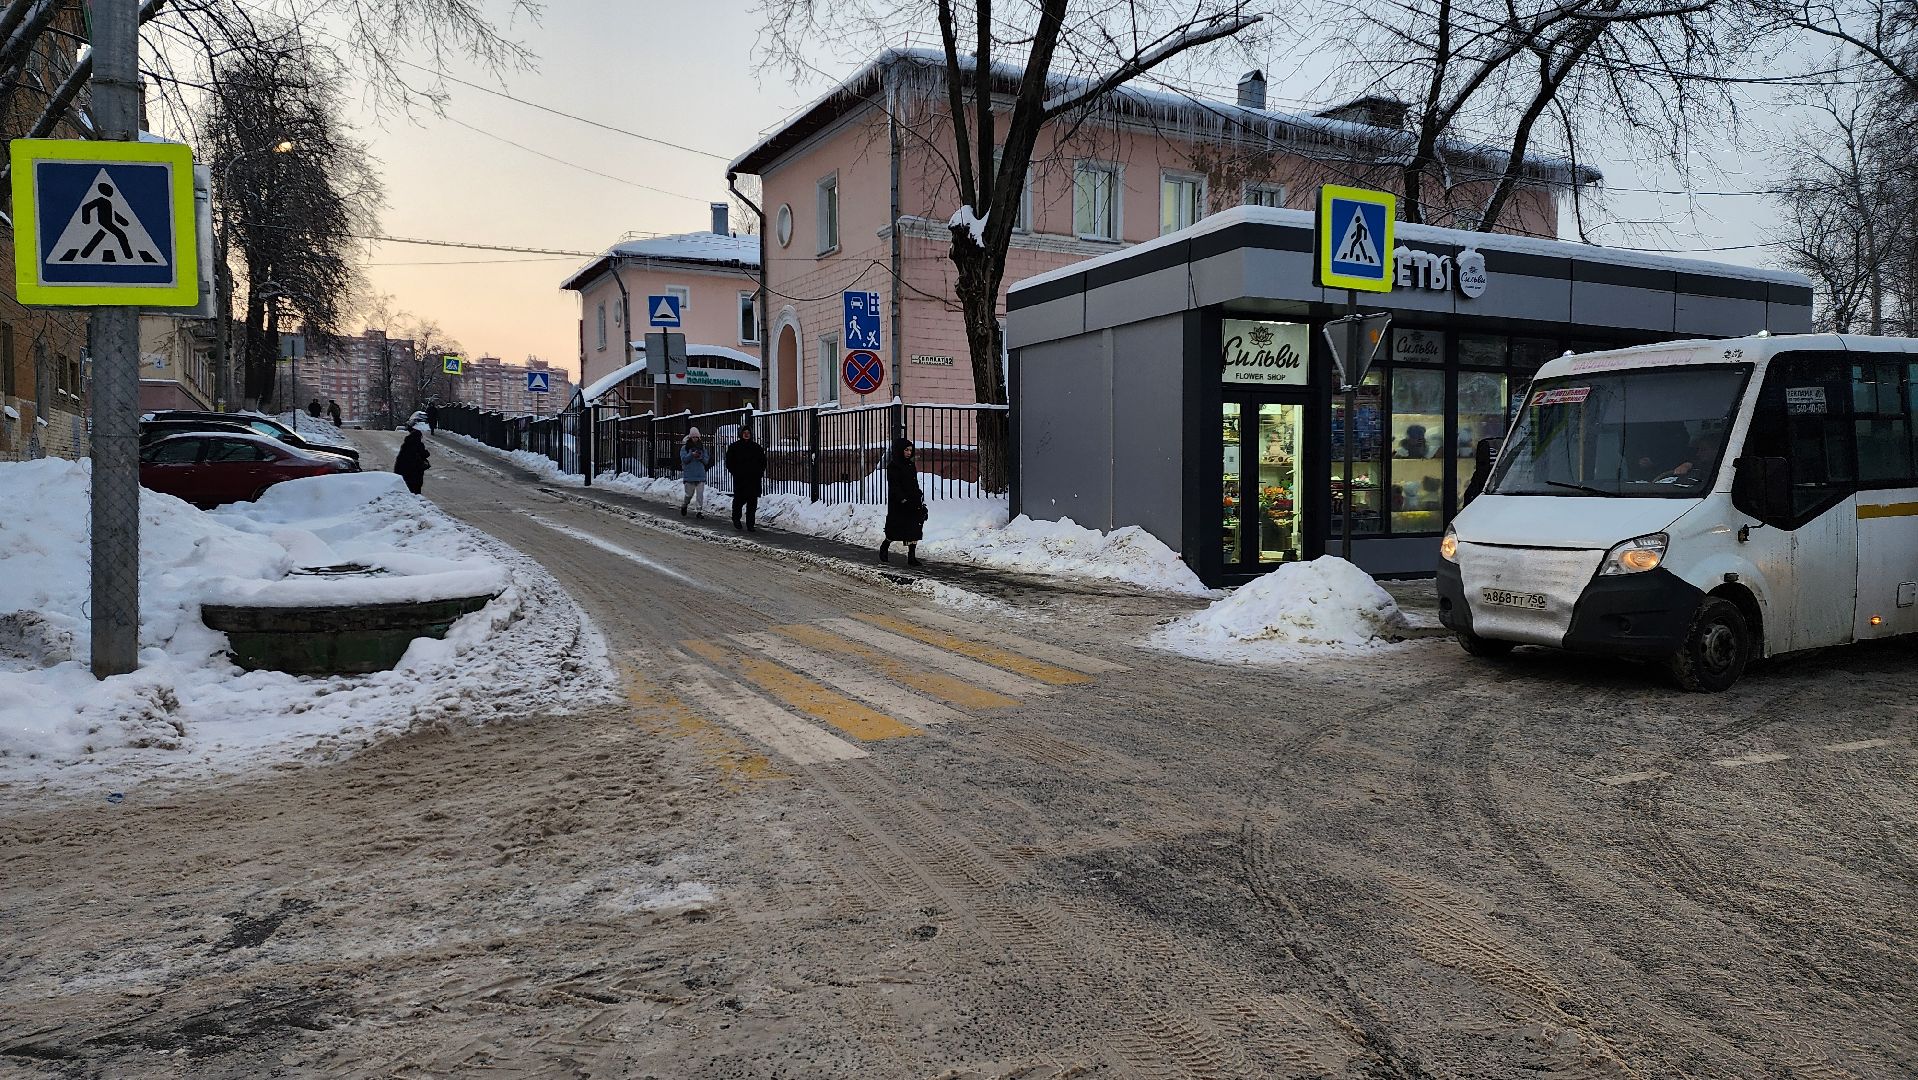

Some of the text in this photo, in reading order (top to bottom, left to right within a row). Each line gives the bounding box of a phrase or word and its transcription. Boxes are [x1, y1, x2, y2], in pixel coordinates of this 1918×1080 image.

[1393, 254, 1452, 291] ЕТЫ
[1221, 336, 1301, 375] Сильви
[686, 369, 709, 377] НАША
[1235, 372, 1286, 381] FLOWER SHOP
[686, 377, 742, 386] ПОЛИКЛИНИКА
[1533, 392, 1547, 405] 2
